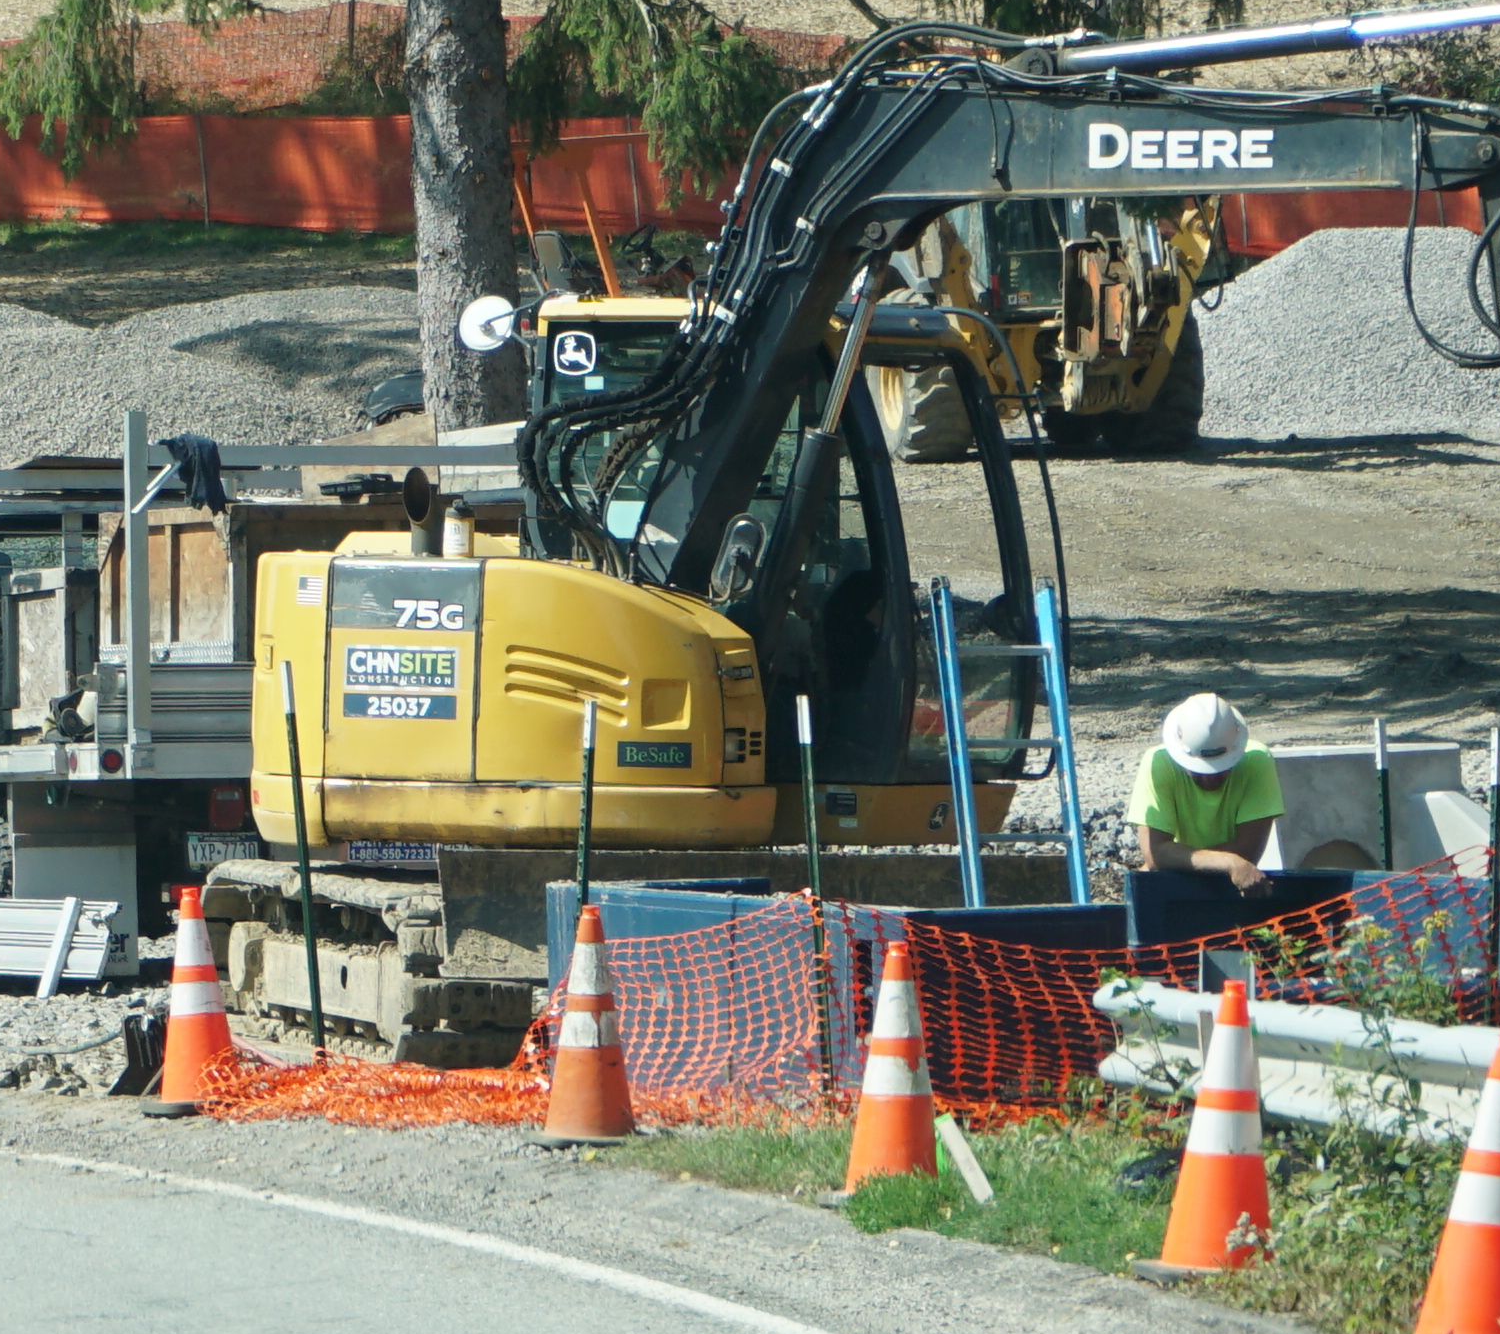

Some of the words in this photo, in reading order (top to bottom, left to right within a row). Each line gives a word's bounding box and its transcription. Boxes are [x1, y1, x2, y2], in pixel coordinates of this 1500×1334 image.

[1088, 122, 1274, 169] DEERE
[392, 598, 464, 630] 75G
[349, 674, 452, 686] CONSTRUCTION
[366, 695, 432, 717] 25037
[624, 746, 685, 764] BeSafe
